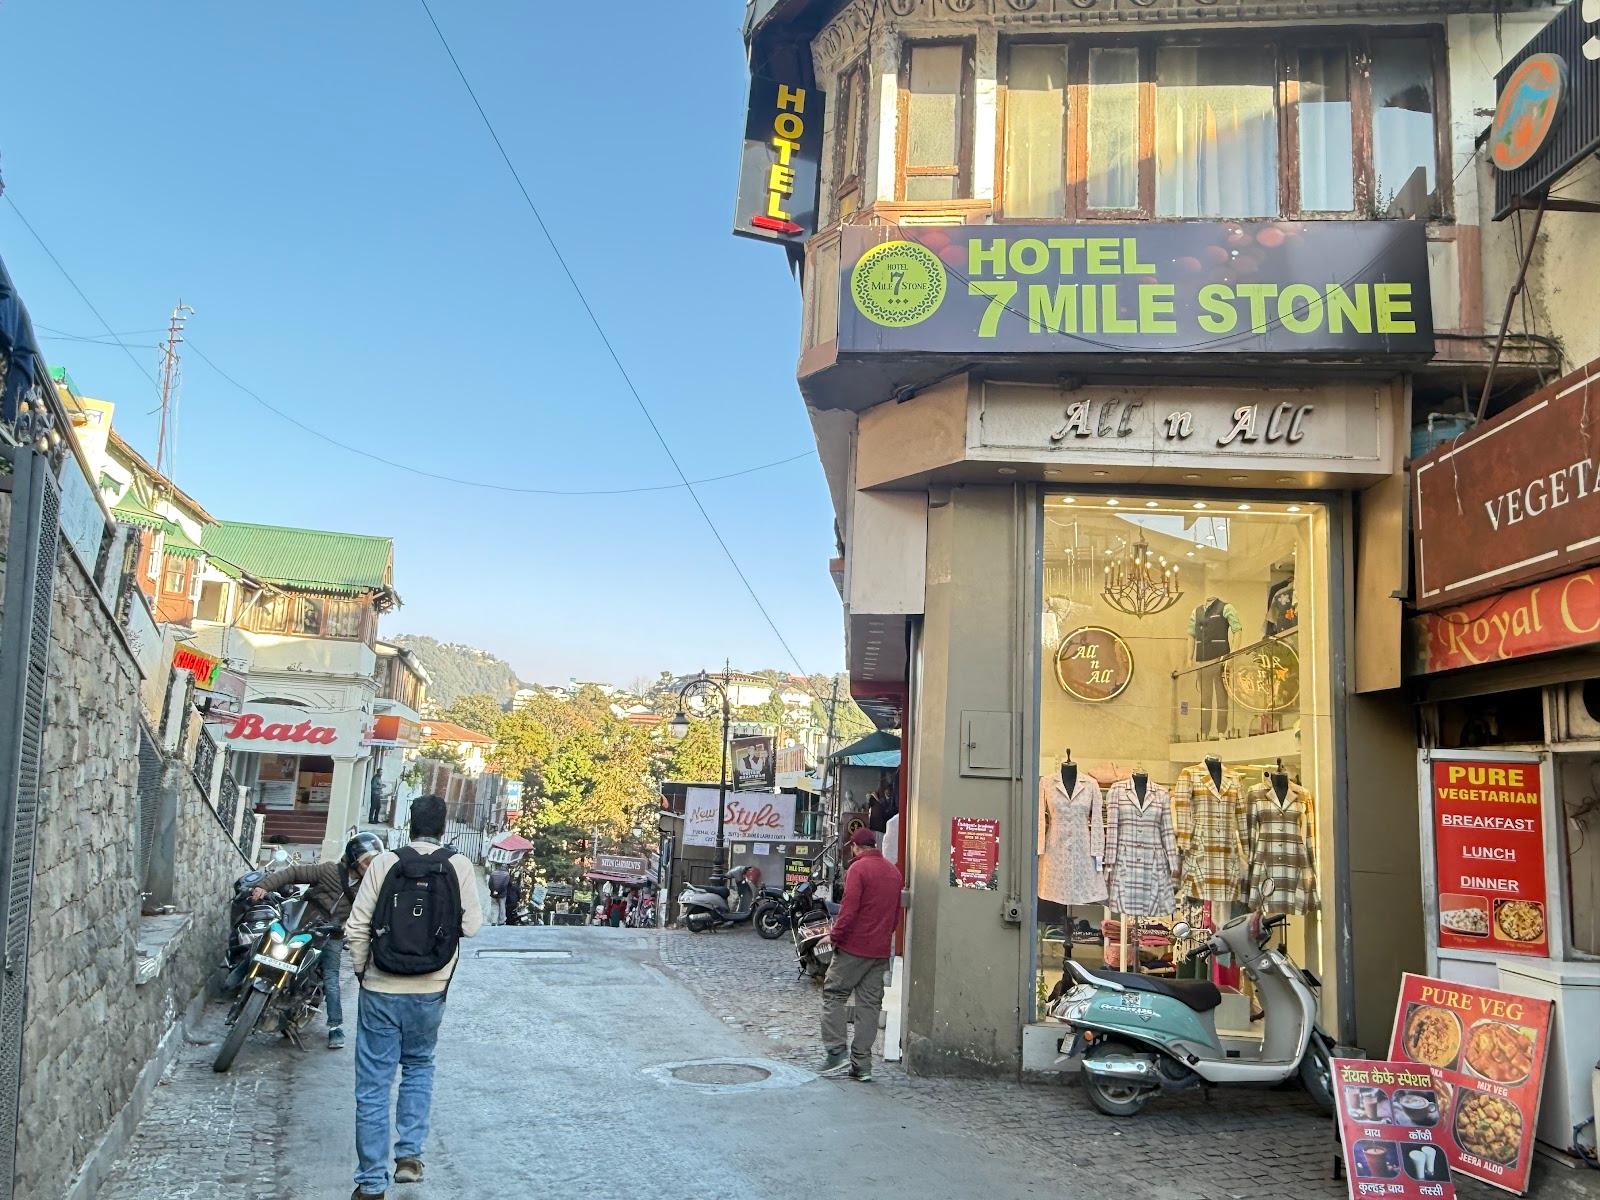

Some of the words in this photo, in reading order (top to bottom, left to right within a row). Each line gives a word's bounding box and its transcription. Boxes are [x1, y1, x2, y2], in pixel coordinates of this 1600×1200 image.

[768, 84, 806, 220] HOTEL
[968, 238, 1156, 275] HOTEL
[887, 263, 908, 271] HOTEL
[890, 272, 905, 295] 7
[901, 281, 928, 290] STONE
[968, 280, 1018, 338] 7
[1028, 284, 1177, 334] MILE
[1197, 283, 1416, 334] STONE
[1051, 399, 1143, 440] All
[1166, 411, 1194, 440] n
[1216, 402, 1313, 447] All
[1437, 587, 1544, 665] Royal
[1072, 645, 1097, 660] All
[1090, 660, 1100, 669] n
[1086, 670, 1113, 684] All
[224, 713, 338, 745] Bata
[1448, 766, 1524, 787] PURE
[1438, 787, 1538, 805] VEGETARIAN
[691, 806, 718, 822] New
[723, 801, 782, 832] Style
[1441, 814, 1535, 831] BREAKFAST
[1462, 846, 1516, 860] LUNCH
[614, 860, 640, 870] GARMENTS
[1460, 875, 1519, 892] DINNER
[1419, 985, 1473, 1011] PURE
[1479, 996, 1525, 1021] VEG
[1341, 1065, 1369, 1083] रॉयल
[1397, 1068, 1432, 1087] स्पेशल
[1476, 1080, 1492, 1093] MIX
[1491, 1083, 1508, 1097] VEG
[1364, 1128, 1381, 1138] चाय
[1459, 1152, 1482, 1168] JEERA
[1483, 1159, 1503, 1176] ALOO
[1388, 1184, 1405, 1194] चाय
[1419, 1183, 1443, 1196] लस्सी
